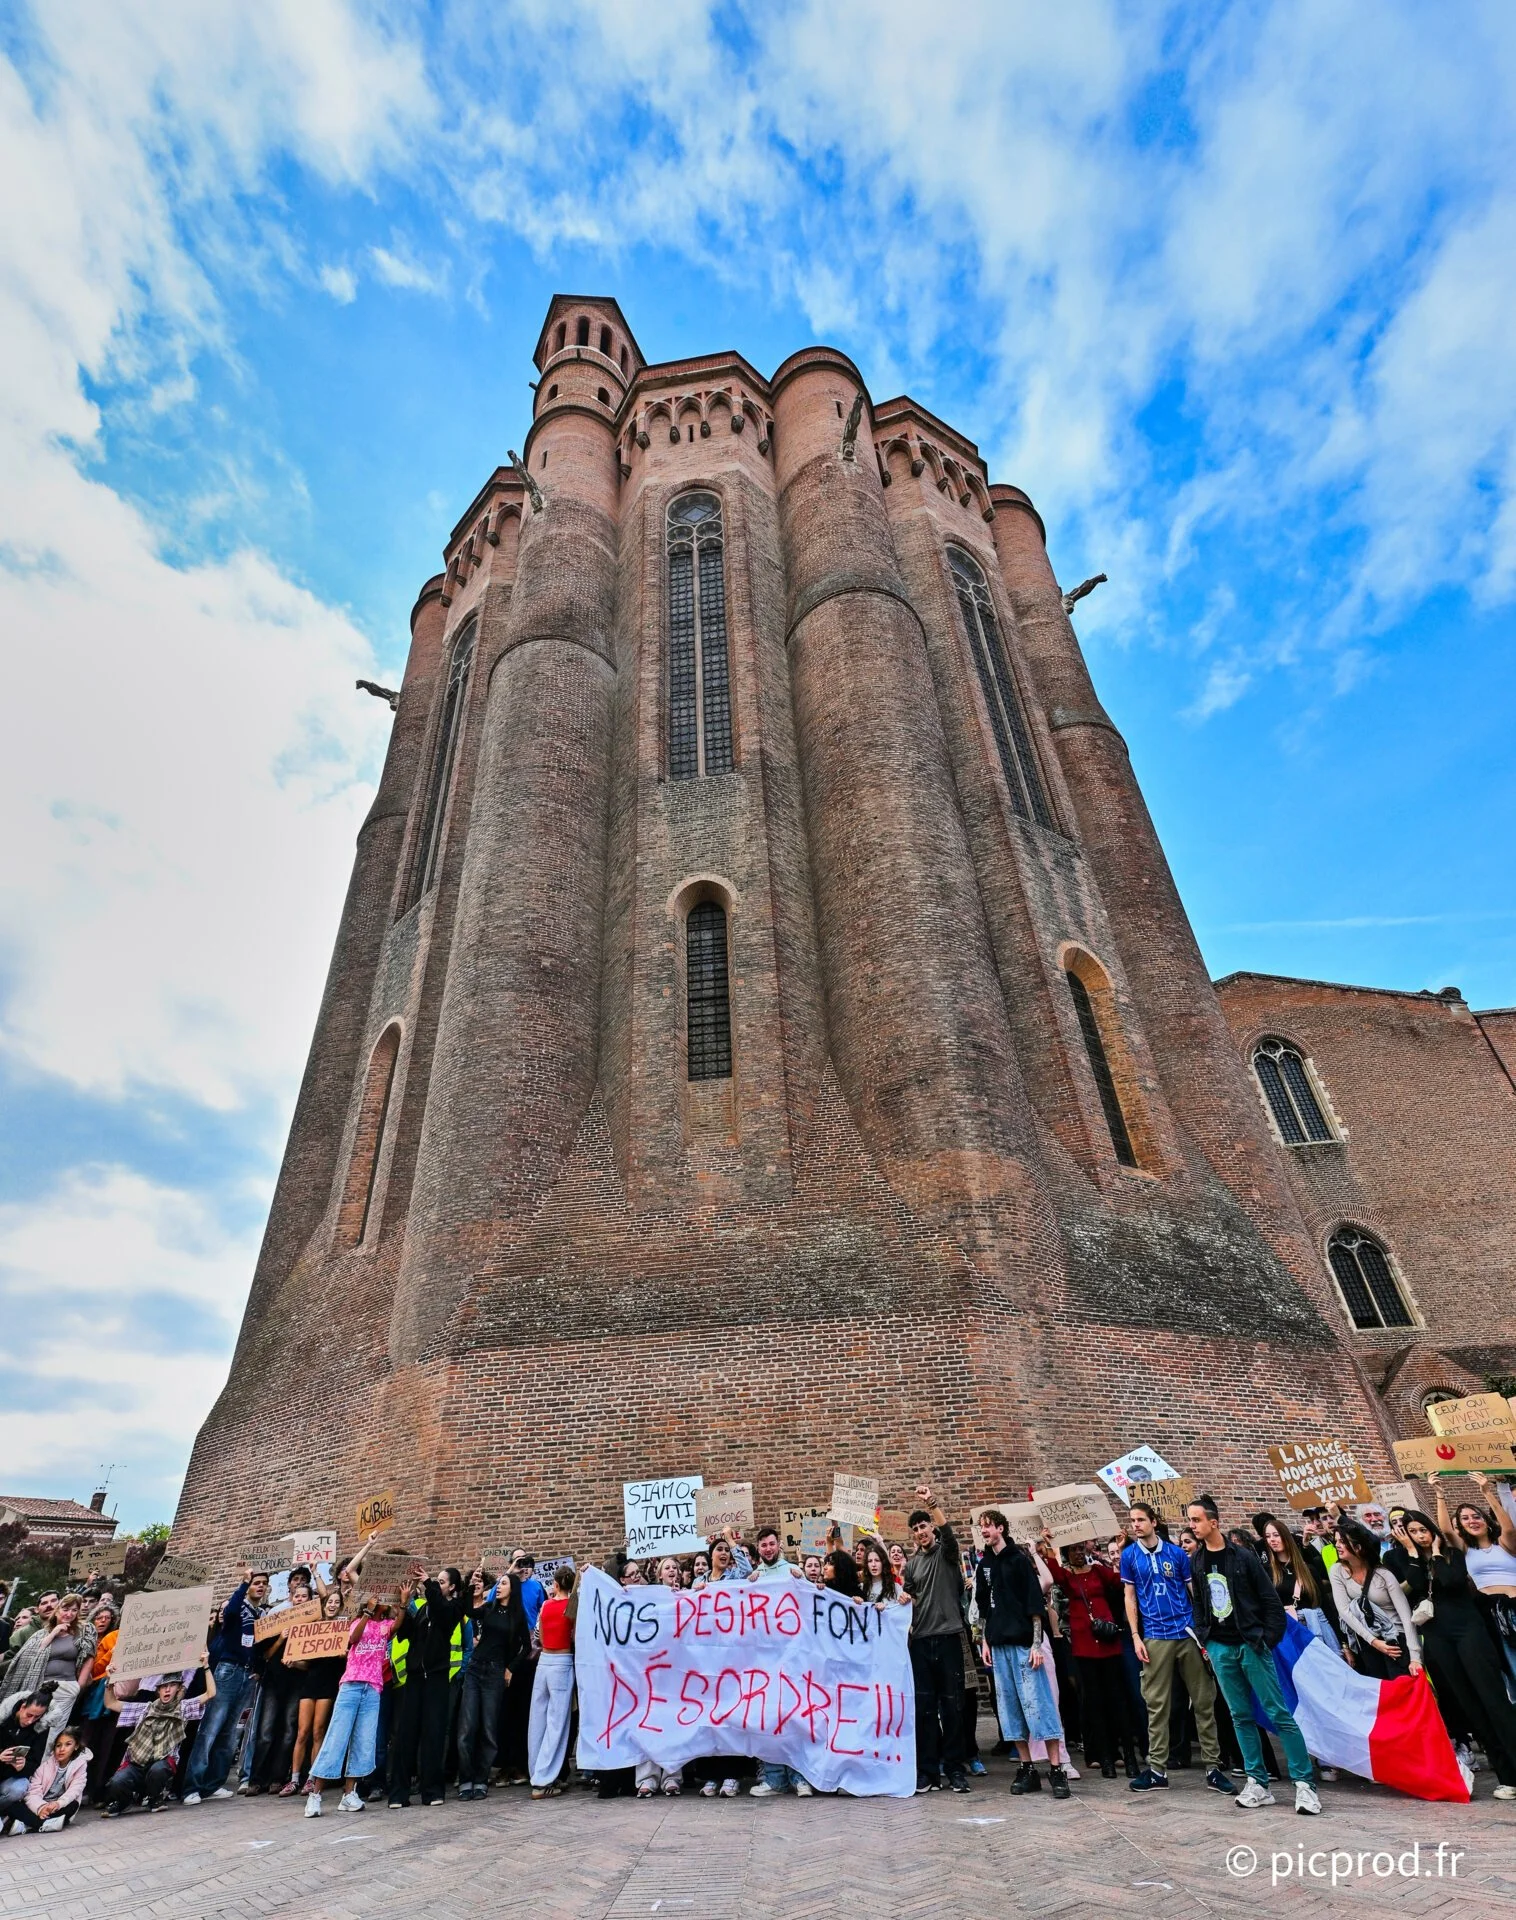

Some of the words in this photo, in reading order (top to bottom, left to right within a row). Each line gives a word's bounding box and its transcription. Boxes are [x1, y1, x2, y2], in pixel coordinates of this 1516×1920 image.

[1435, 1404, 1461, 1416] CEUX
[1466, 1398, 1487, 1408] QUI
[1447, 1408, 1491, 1424] VIVENT
[1464, 1420, 1491, 1432] CEUX
[1492, 1417, 1513, 1427] QUI
[1279, 1445, 1308, 1464] LA
[1457, 1443, 1483, 1452] SOIT
[1488, 1443, 1511, 1451] AVEC
[1469, 1455, 1503, 1464] NOUS
[1280, 1463, 1315, 1482] NOUS
[1335, 1467, 1358, 1482] LES
[627, 1482, 690, 1506] SIAMO
[1141, 1481, 1166, 1498] FAIS
[1315, 1483, 1358, 1504] YEUX
[641, 1503, 694, 1522] TUTTI
[704, 1514, 719, 1528] NOS
[720, 1510, 748, 1524] CODES
[252, 1545, 269, 1554] FEUX
[271, 1544, 280, 1552] DE
[635, 1542, 657, 1555] 1312
[260, 1557, 292, 1571] ORDURES
[543, 1561, 560, 1572] CRS
[1152, 1582, 1167, 1596] 27
[594, 1588, 659, 1646] NOS
